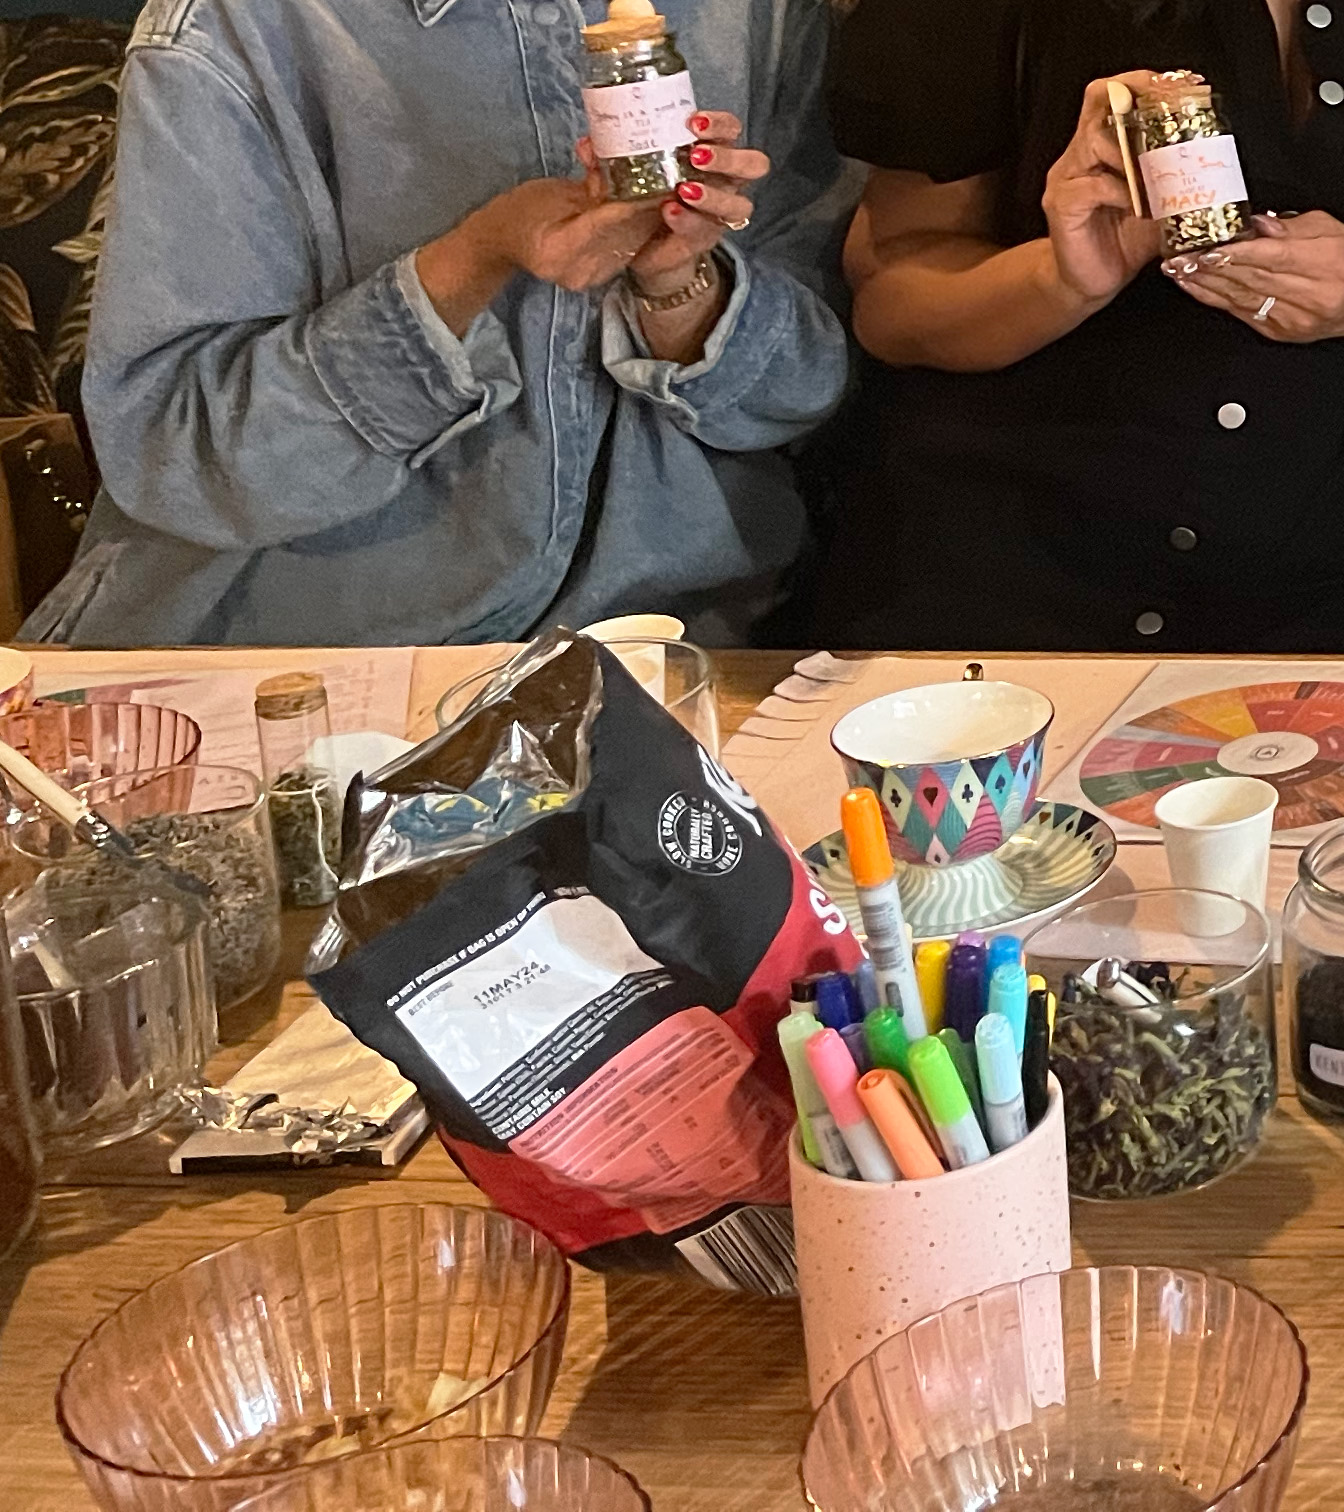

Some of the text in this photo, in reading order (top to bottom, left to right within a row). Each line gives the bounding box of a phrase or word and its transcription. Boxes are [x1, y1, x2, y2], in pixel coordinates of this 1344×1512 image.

[662, 796, 686, 837] COOKED
[700, 812, 713, 860] CRAFTED
[473, 961, 539, 1002] 11MAY24
[550, 1087, 566, 1103] SOY
